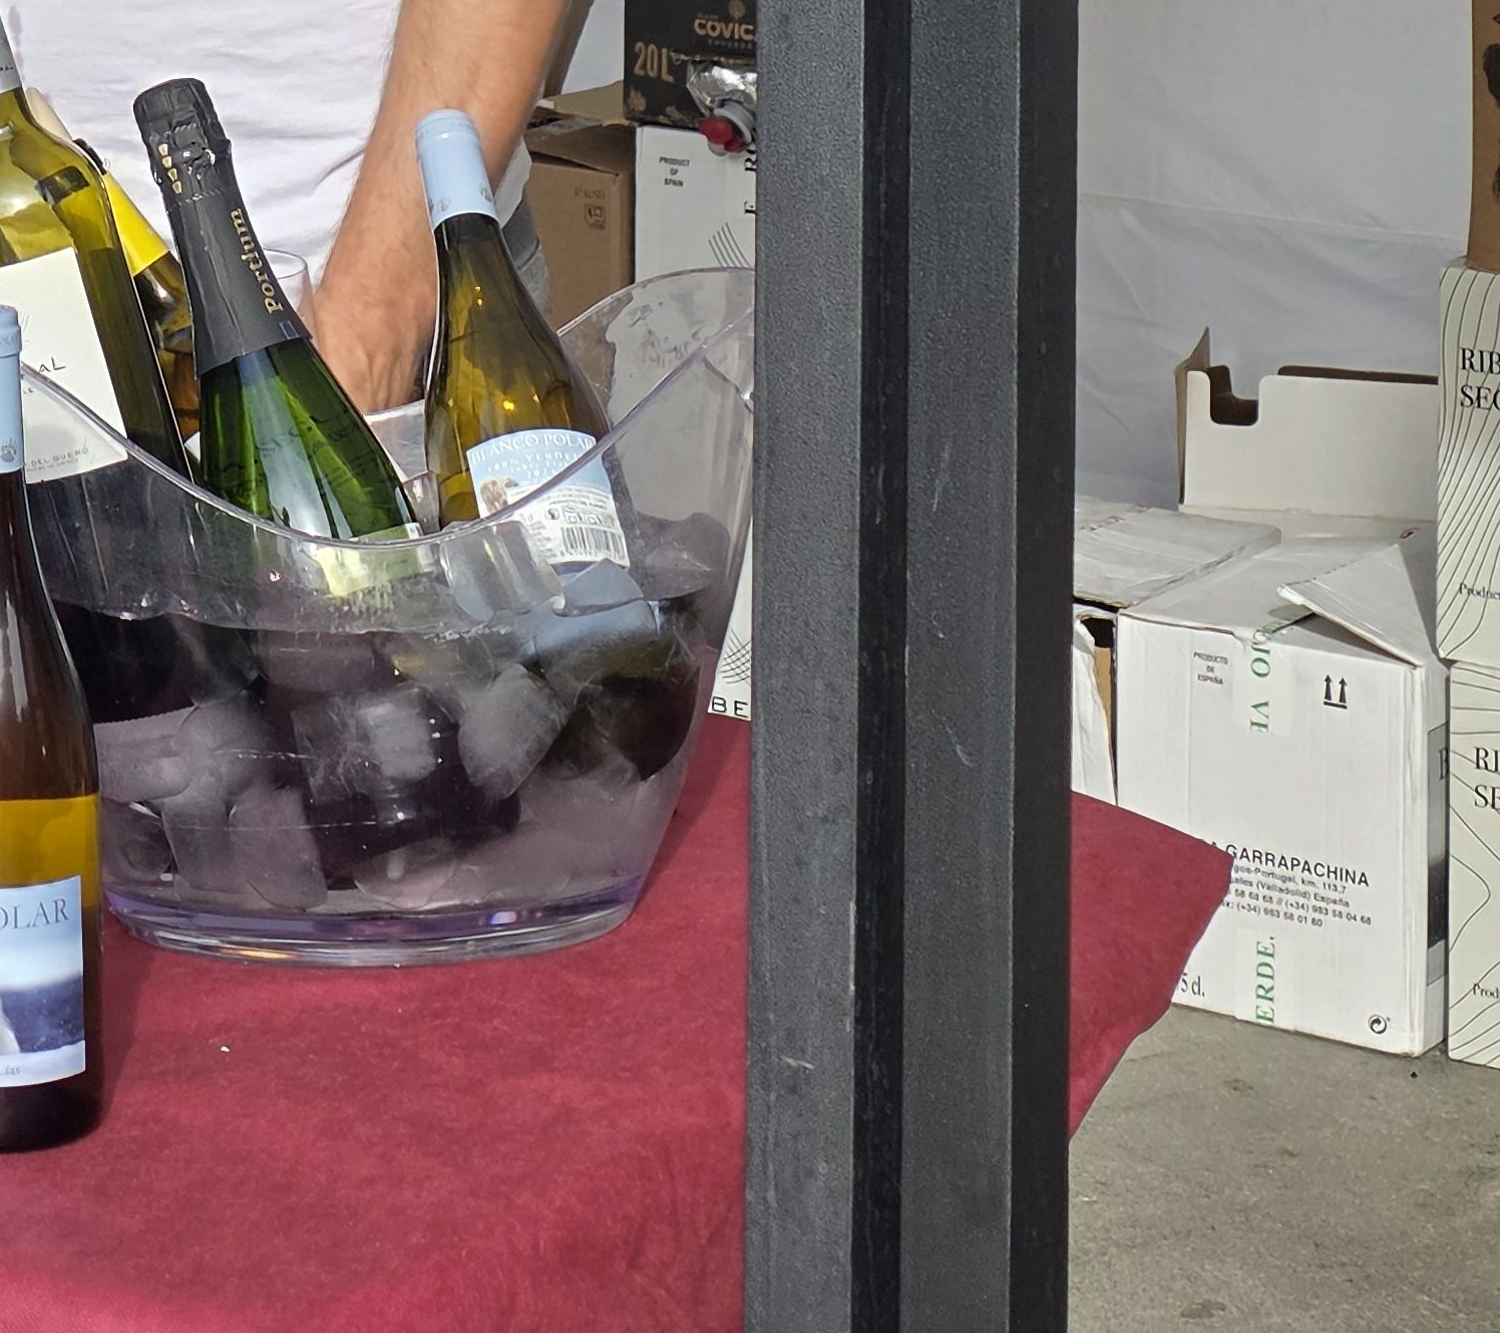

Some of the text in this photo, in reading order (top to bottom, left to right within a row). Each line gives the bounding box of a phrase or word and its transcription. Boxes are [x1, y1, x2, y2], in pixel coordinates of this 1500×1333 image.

[659, 156, 691, 167] PRODUCT
[230, 207, 284, 315] Portium
[471, 433, 540, 465] BLANCO
[1193, 651, 1228, 665] PRODUCTO
[1226, 844, 1370, 887] GARRAPACHINA
[1313, 892, 1350, 909] España
